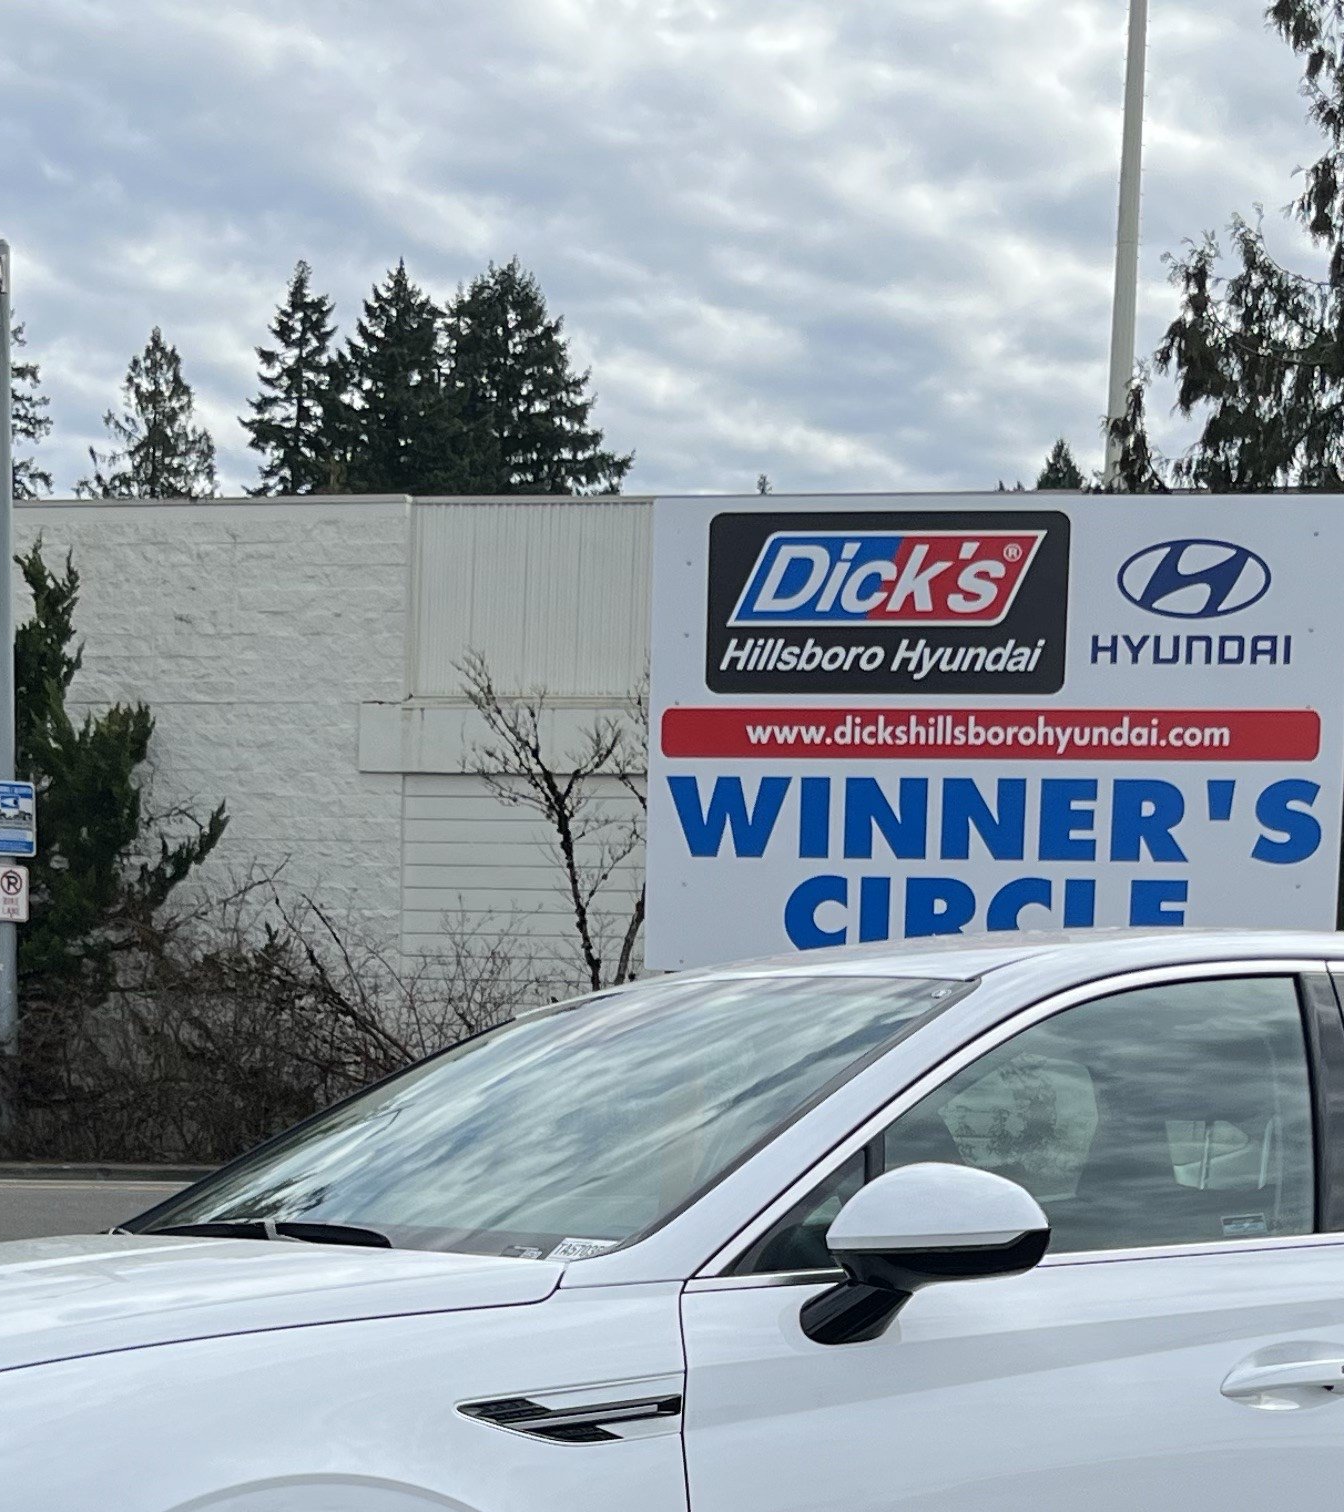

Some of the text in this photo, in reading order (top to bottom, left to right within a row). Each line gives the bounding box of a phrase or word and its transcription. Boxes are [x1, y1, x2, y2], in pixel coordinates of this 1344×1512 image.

[719, 638, 1046, 680] Hillsboro Hyundai
[1090, 634, 1292, 665] HYUNDAI
[746, 714, 1231, 754] www.dickshillsborohyundai.com
[667, 775, 1323, 865] WINNER'S
